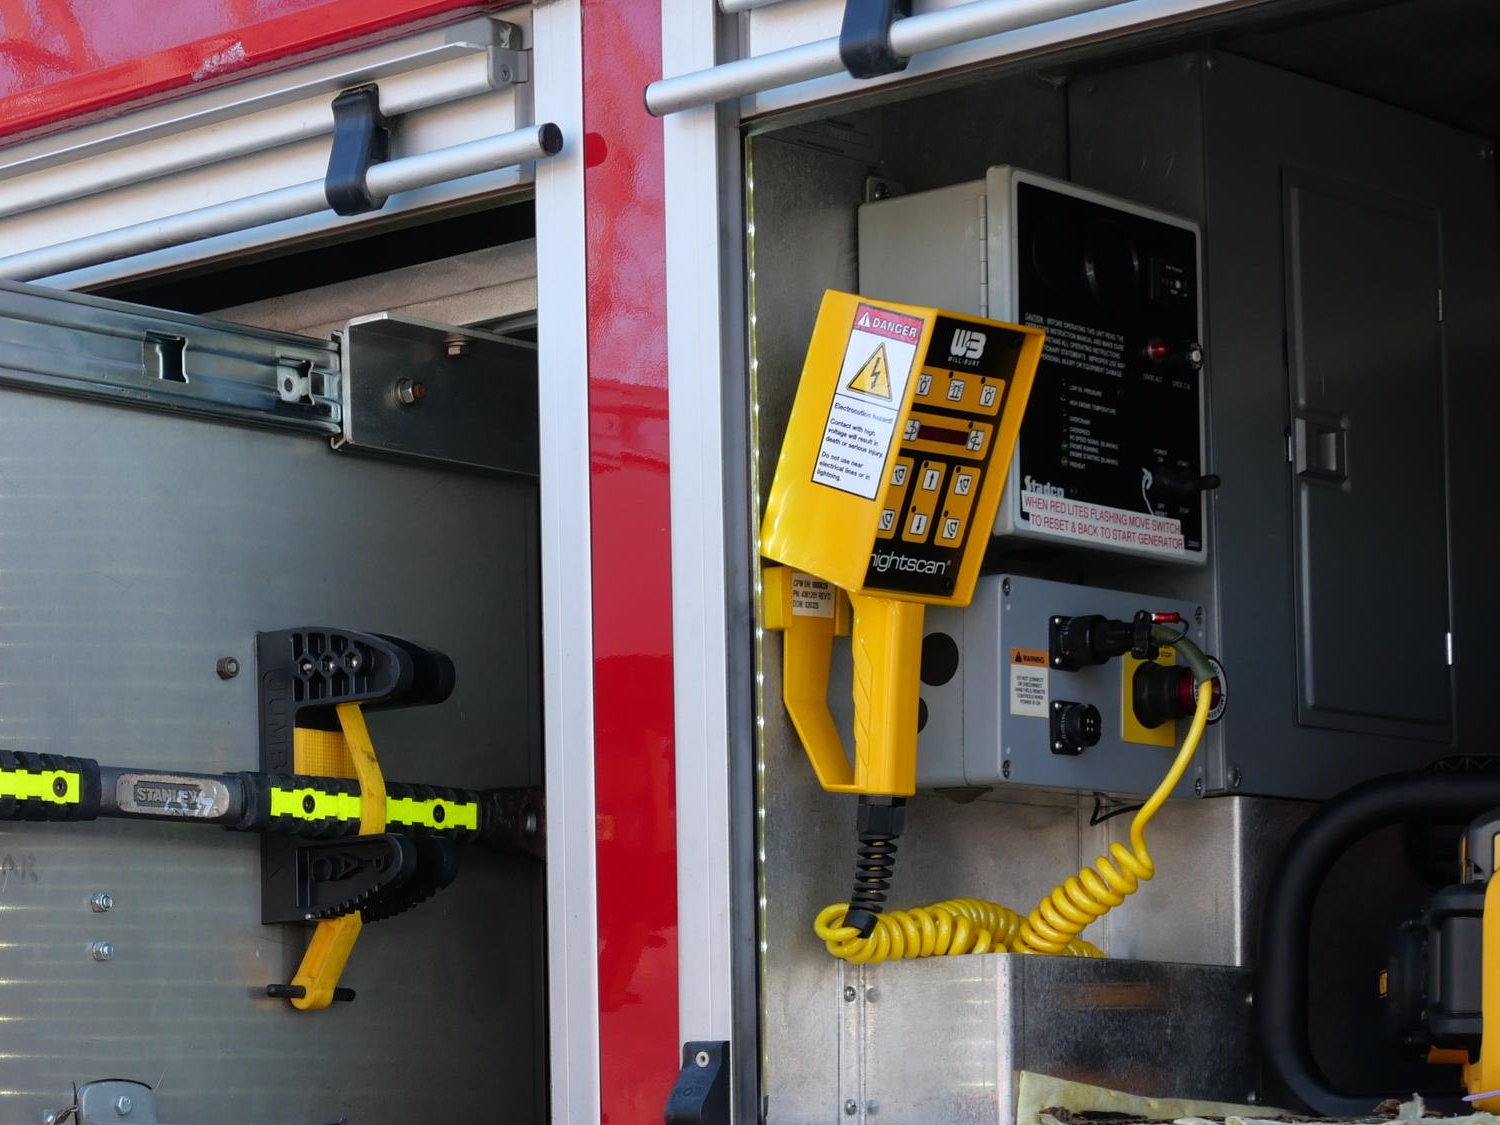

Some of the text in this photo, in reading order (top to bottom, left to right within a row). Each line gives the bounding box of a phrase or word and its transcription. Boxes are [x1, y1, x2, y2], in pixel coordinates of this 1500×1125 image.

[872, 317, 918, 338] DANGER
[834, 402, 871, 418] Electrocution
[830, 418, 875, 437] Contact with high
[826, 436, 841, 446] death
[848, 443, 867, 453] serious
[828, 428, 847, 438] voltage
[848, 433, 857, 441] will
[858, 436, 873, 446] result
[819, 460, 844, 472] electrical
[844, 466, 858, 477] lines
[821, 451, 864, 469] Do not use near
[1024, 475, 1065, 498] Stadco
[1024, 495, 1181, 535] WHEN RED LITES FLASHING MOVE SWITCH
[1030, 514, 1042, 527] TO
[1043, 516, 1069, 532] RESET
[1071, 522, 1077, 533] &
[1078, 522, 1099, 537] BACK
[1100, 526, 1111, 539] TO
[1112, 528, 1137, 544] START
[1138, 532, 1184, 551] GENERATOR
[1022, 655, 1045, 664] WARNING
[137, 787, 199, 804] STANLEY
